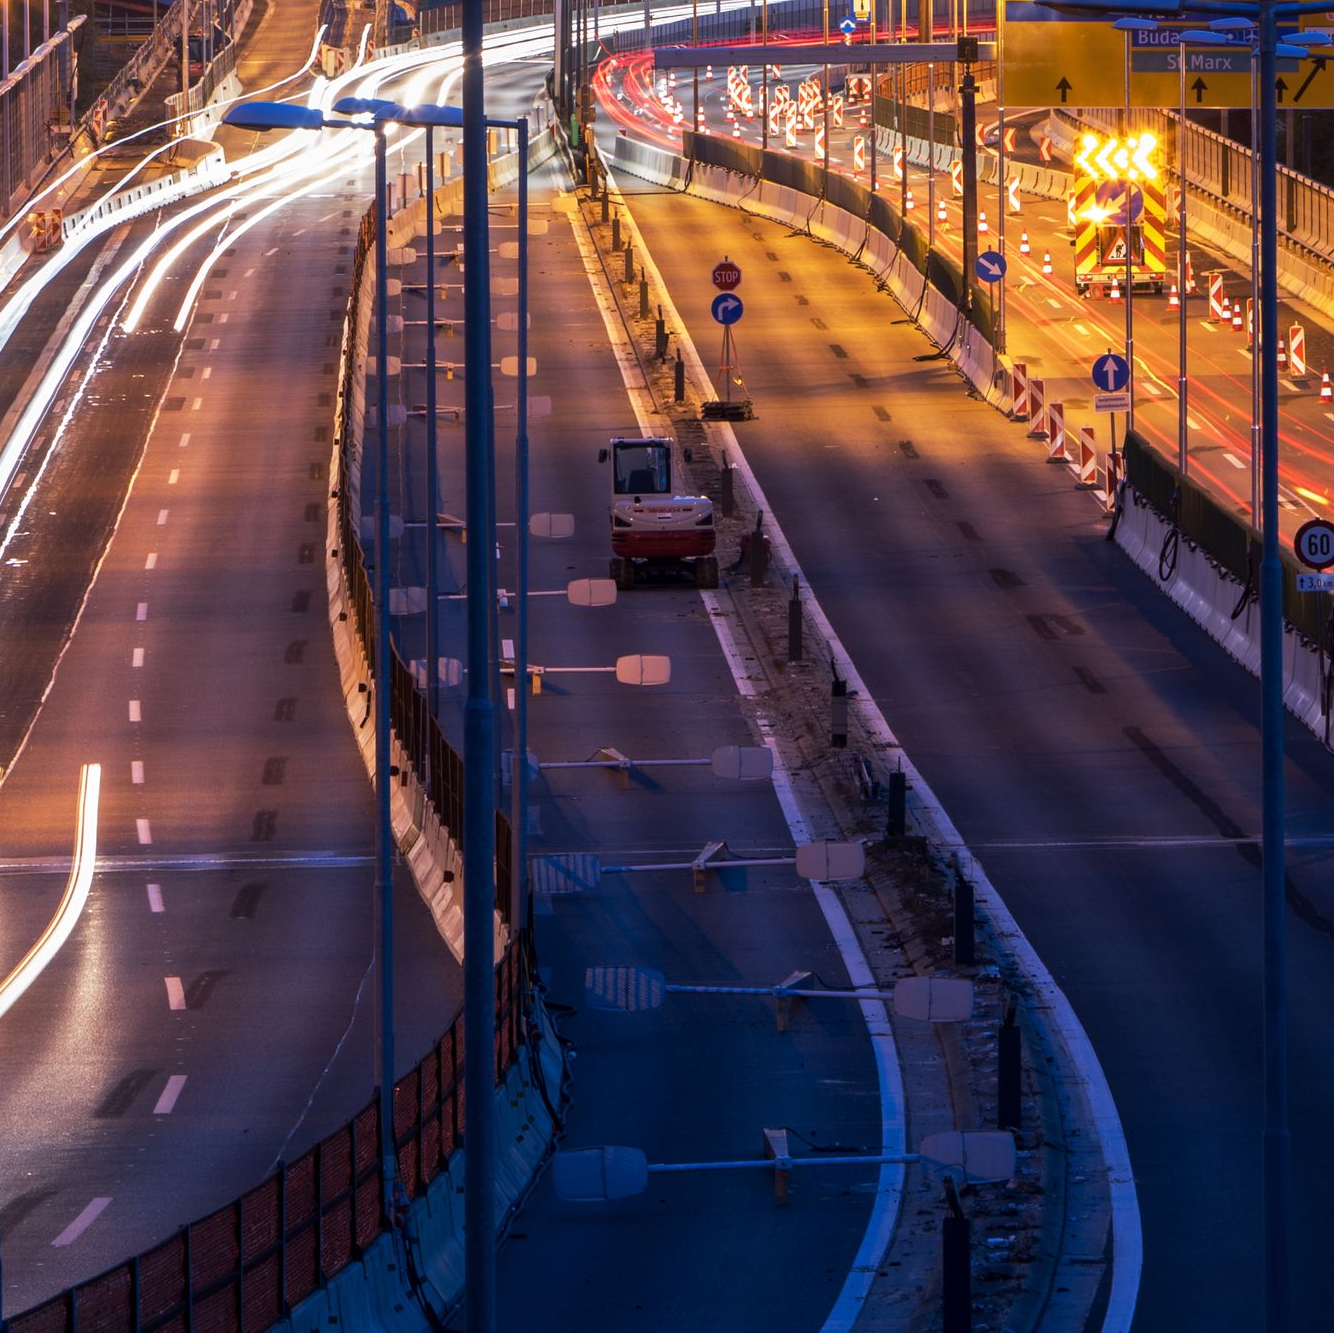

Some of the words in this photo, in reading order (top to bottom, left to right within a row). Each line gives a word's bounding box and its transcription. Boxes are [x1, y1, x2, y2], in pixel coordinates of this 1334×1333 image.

[1191, 54, 1232, 69] Marx
[714, 271, 738, 283] STOP
[1308, 533, 1330, 556] 60
[1308, 577, 1322, 589] 3,0
[1323, 580, 1334, 588] km
